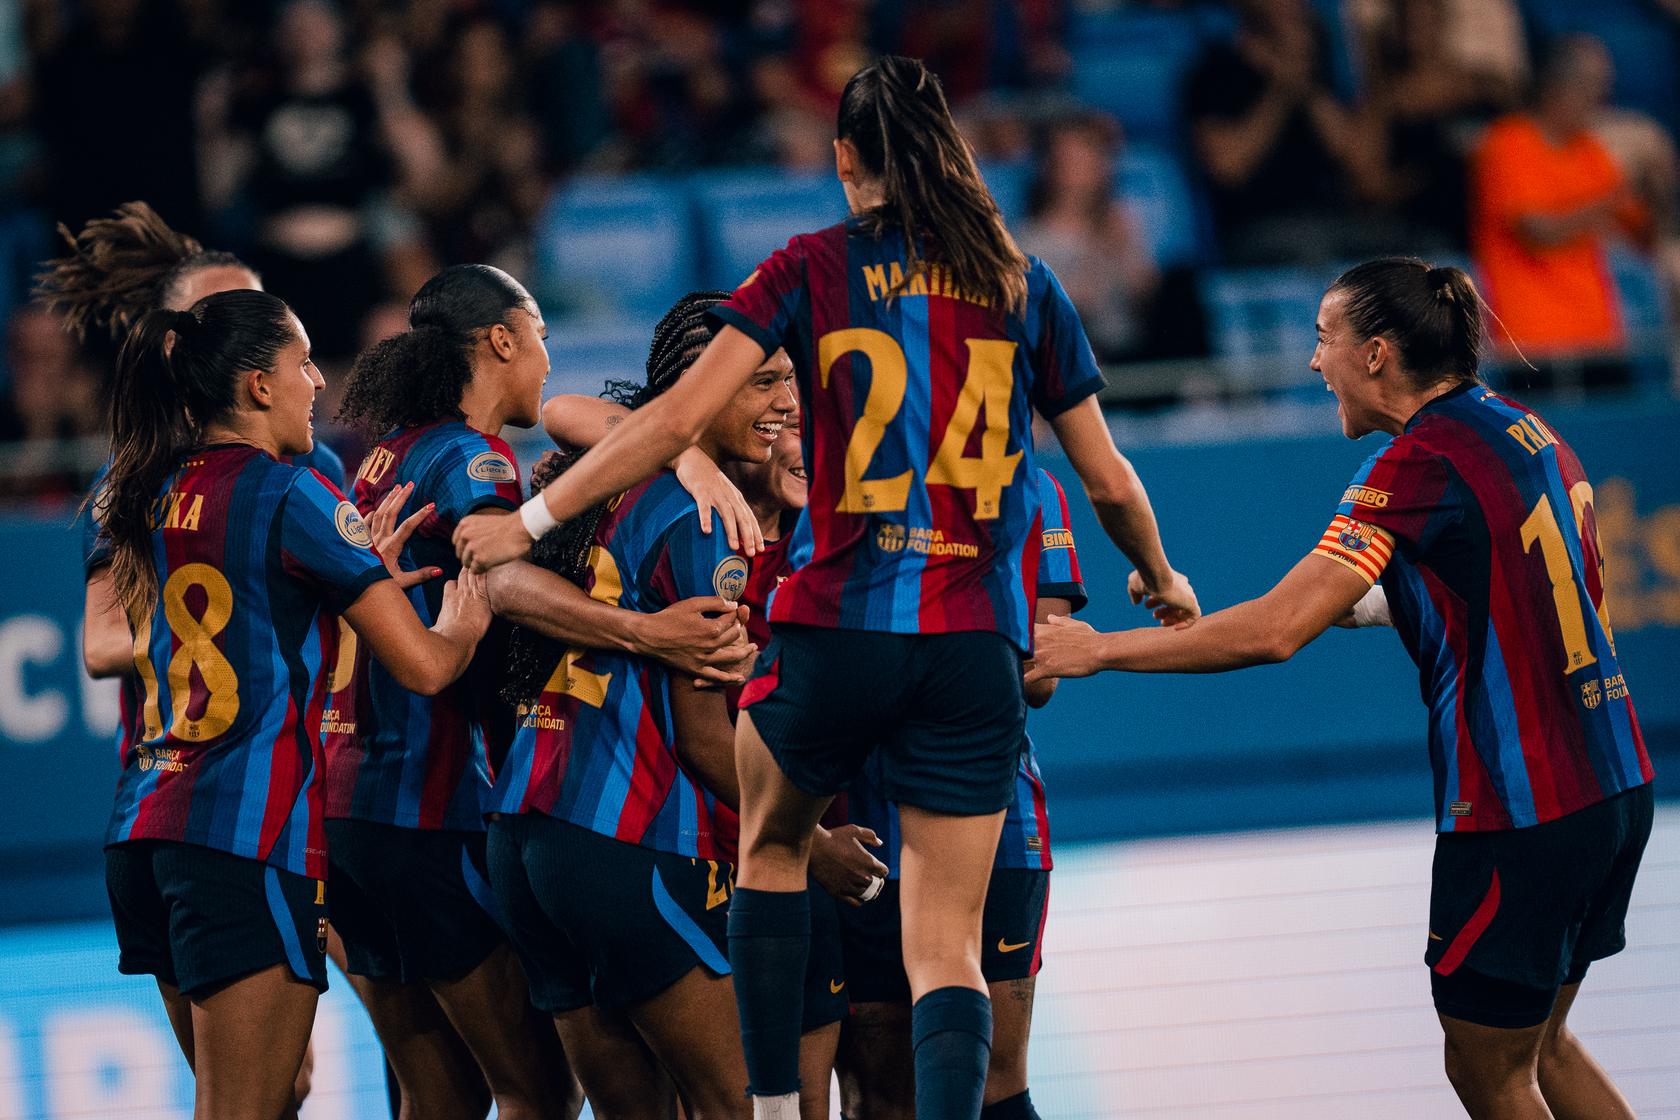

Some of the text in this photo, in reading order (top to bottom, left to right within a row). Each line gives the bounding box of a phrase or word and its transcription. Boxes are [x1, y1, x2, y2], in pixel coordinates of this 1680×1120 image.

[818, 327, 1024, 520] 24
[1342, 488, 1389, 508] BIMBO
[1042, 532, 1073, 547] BIM
[1604, 674, 1625, 689] BAR
[322, 709, 340, 722] ARÇA
